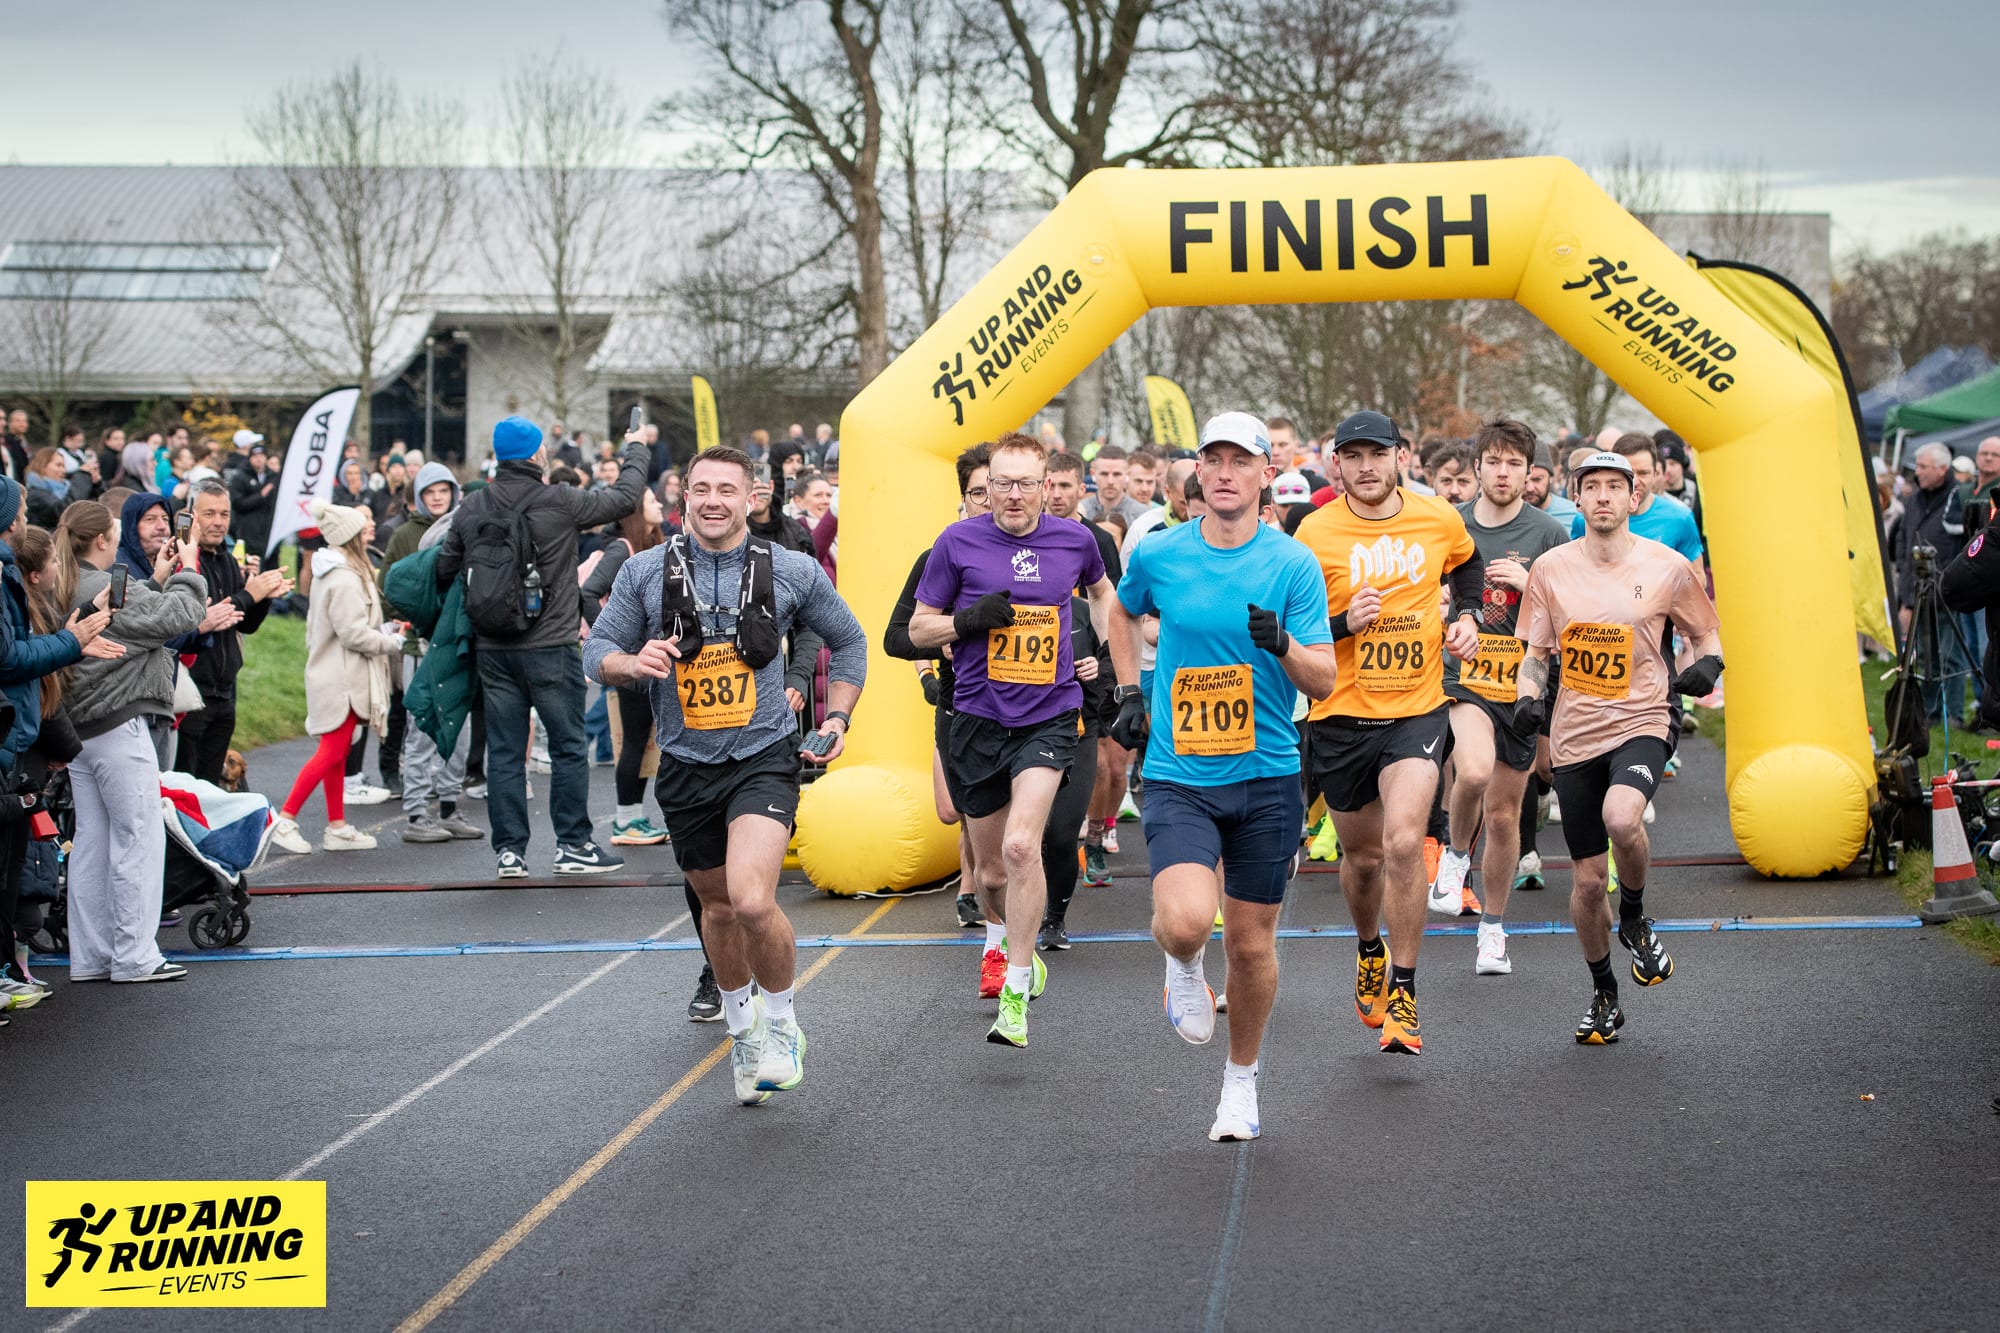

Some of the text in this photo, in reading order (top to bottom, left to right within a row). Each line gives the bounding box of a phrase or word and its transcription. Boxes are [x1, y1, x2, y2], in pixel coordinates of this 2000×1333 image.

[1169, 194, 1490, 274] FINISH
[967, 264, 1052, 356] UP AND
[1636, 284, 1738, 362] UP AND
[975, 269, 1083, 388] RUNNING
[1020, 318, 1070, 373] EVENTS
[1604, 297, 1736, 393] RUNNING
[1623, 339, 1683, 385] EVENTS
[299, 409, 334, 495] KOBA
[1013, 617, 1054, 627] RUNNING
[1017, 610, 1051, 619] UP AND
[1377, 622, 1421, 634] RUNNING
[1382, 614, 1416, 626] UP AND
[1498, 639, 1517, 647] AND
[1581, 634, 1625, 644] RUNNING
[1586, 627, 1599, 635] UP
[701, 651, 714, 661] UP
[993, 633, 1055, 664] 2193
[1359, 640, 1424, 670] 2098
[1481, 646, 1520, 654] RUNNING
[1566, 647, 1627, 680] 2025
[1194, 677, 1243, 692] RUNNING
[1197, 669, 1237, 683] UP AND
[1466, 658, 1518, 684] 2214
[683, 672, 750, 708] 2387
[1177, 698, 1249, 732] 2109
